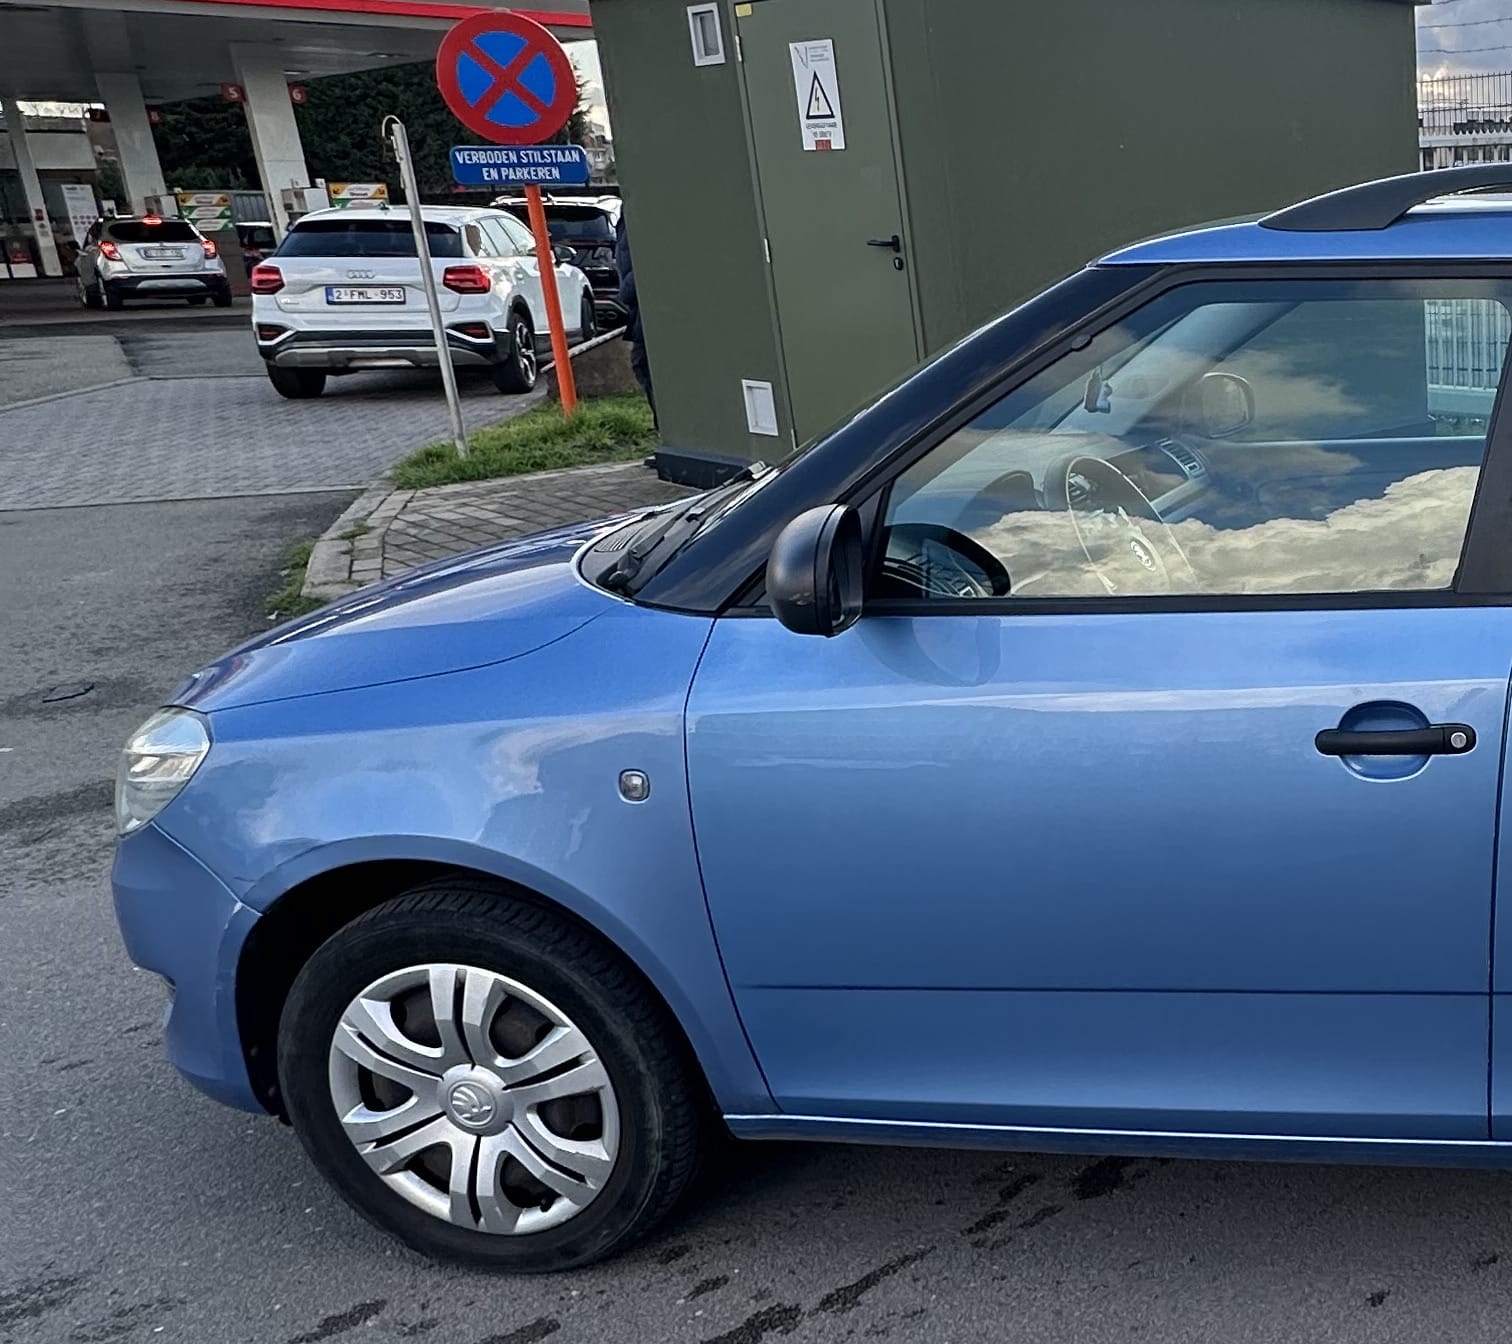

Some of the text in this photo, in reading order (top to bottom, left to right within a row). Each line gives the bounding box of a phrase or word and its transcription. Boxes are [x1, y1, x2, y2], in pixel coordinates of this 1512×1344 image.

[228, 87, 238, 98] 5
[292, 89, 301, 100] 6
[455, 150, 580, 164] VERBODEN STILSTAAN
[482, 166, 560, 181] EN PARKEREN
